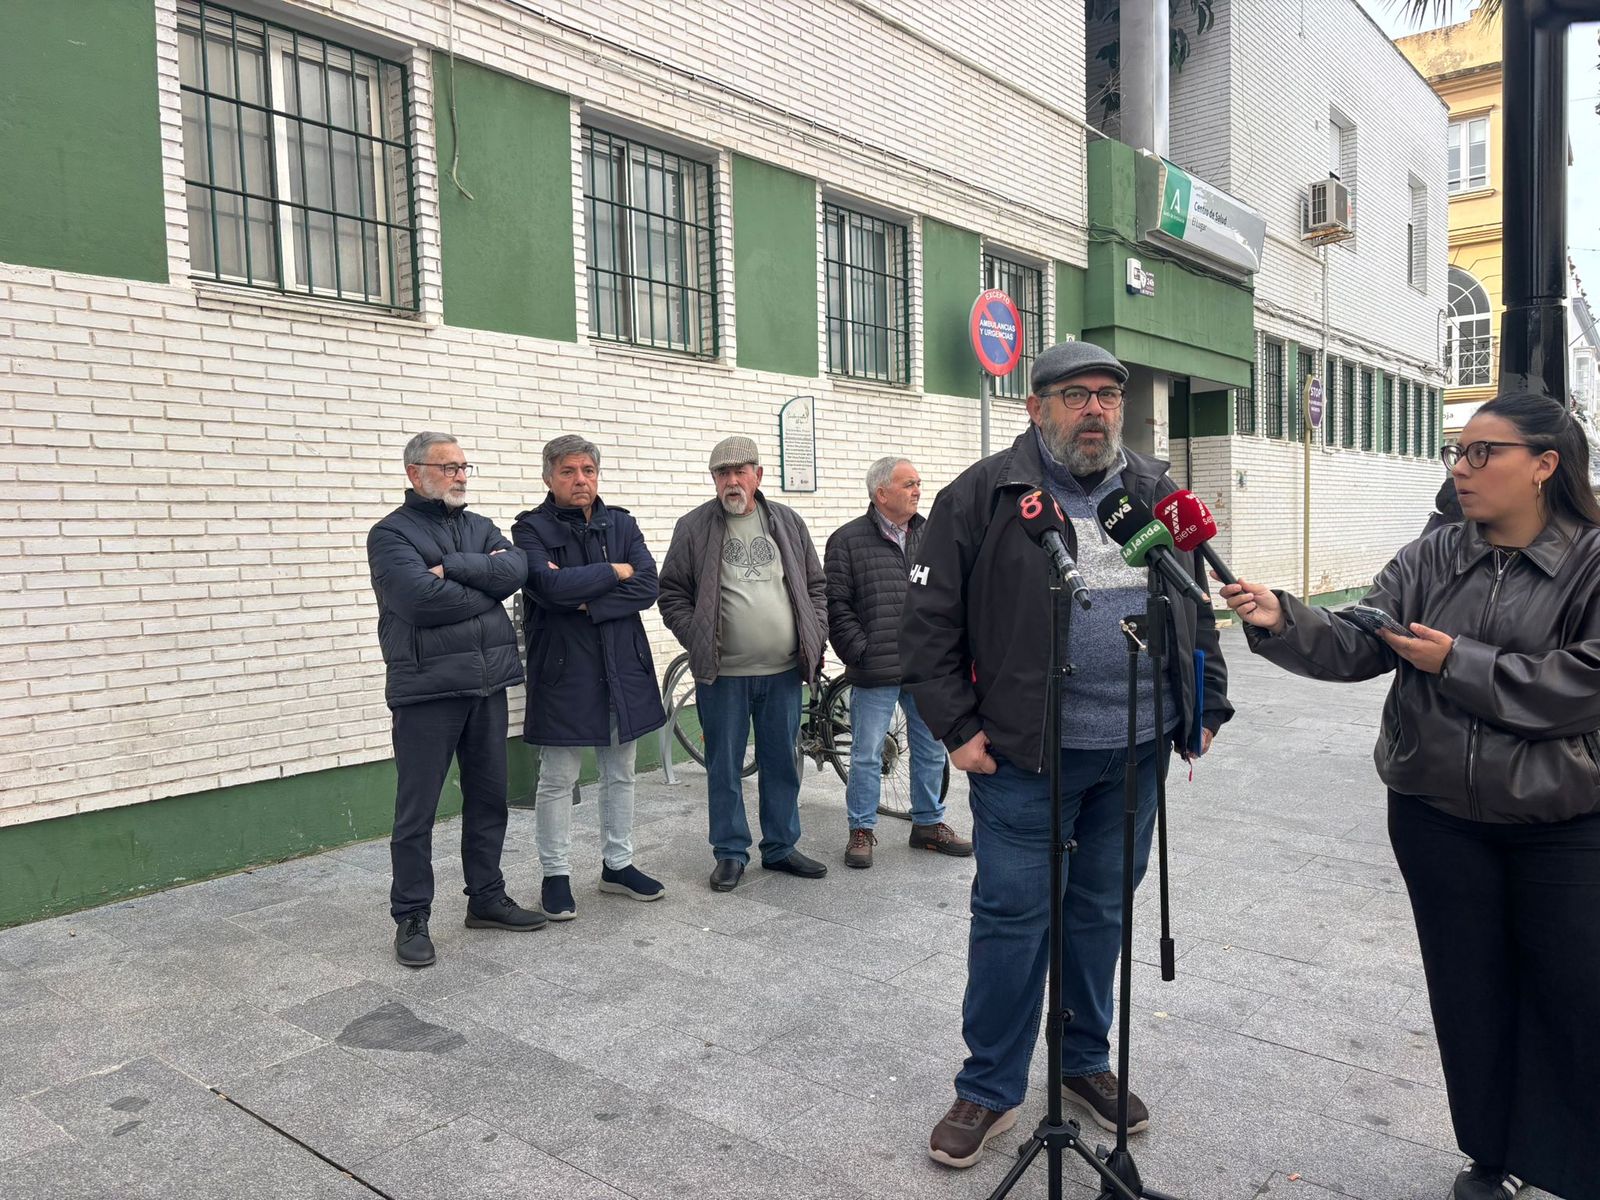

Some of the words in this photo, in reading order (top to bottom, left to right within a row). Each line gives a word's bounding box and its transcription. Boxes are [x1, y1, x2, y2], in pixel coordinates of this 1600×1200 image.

[1194, 201, 1209, 217] Centro
[1215, 211, 1228, 226] Salud
[985, 291, 1010, 305] EXCEPTO
[980, 319, 1016, 333] AMBULANCIAS
[983, 329, 1014, 341] URGENCIAS
[1310, 386, 1322, 398] STOP
[1175, 524, 1198, 543] siete
[1122, 547, 1133, 559] la
[1131, 523, 1161, 552] janda
